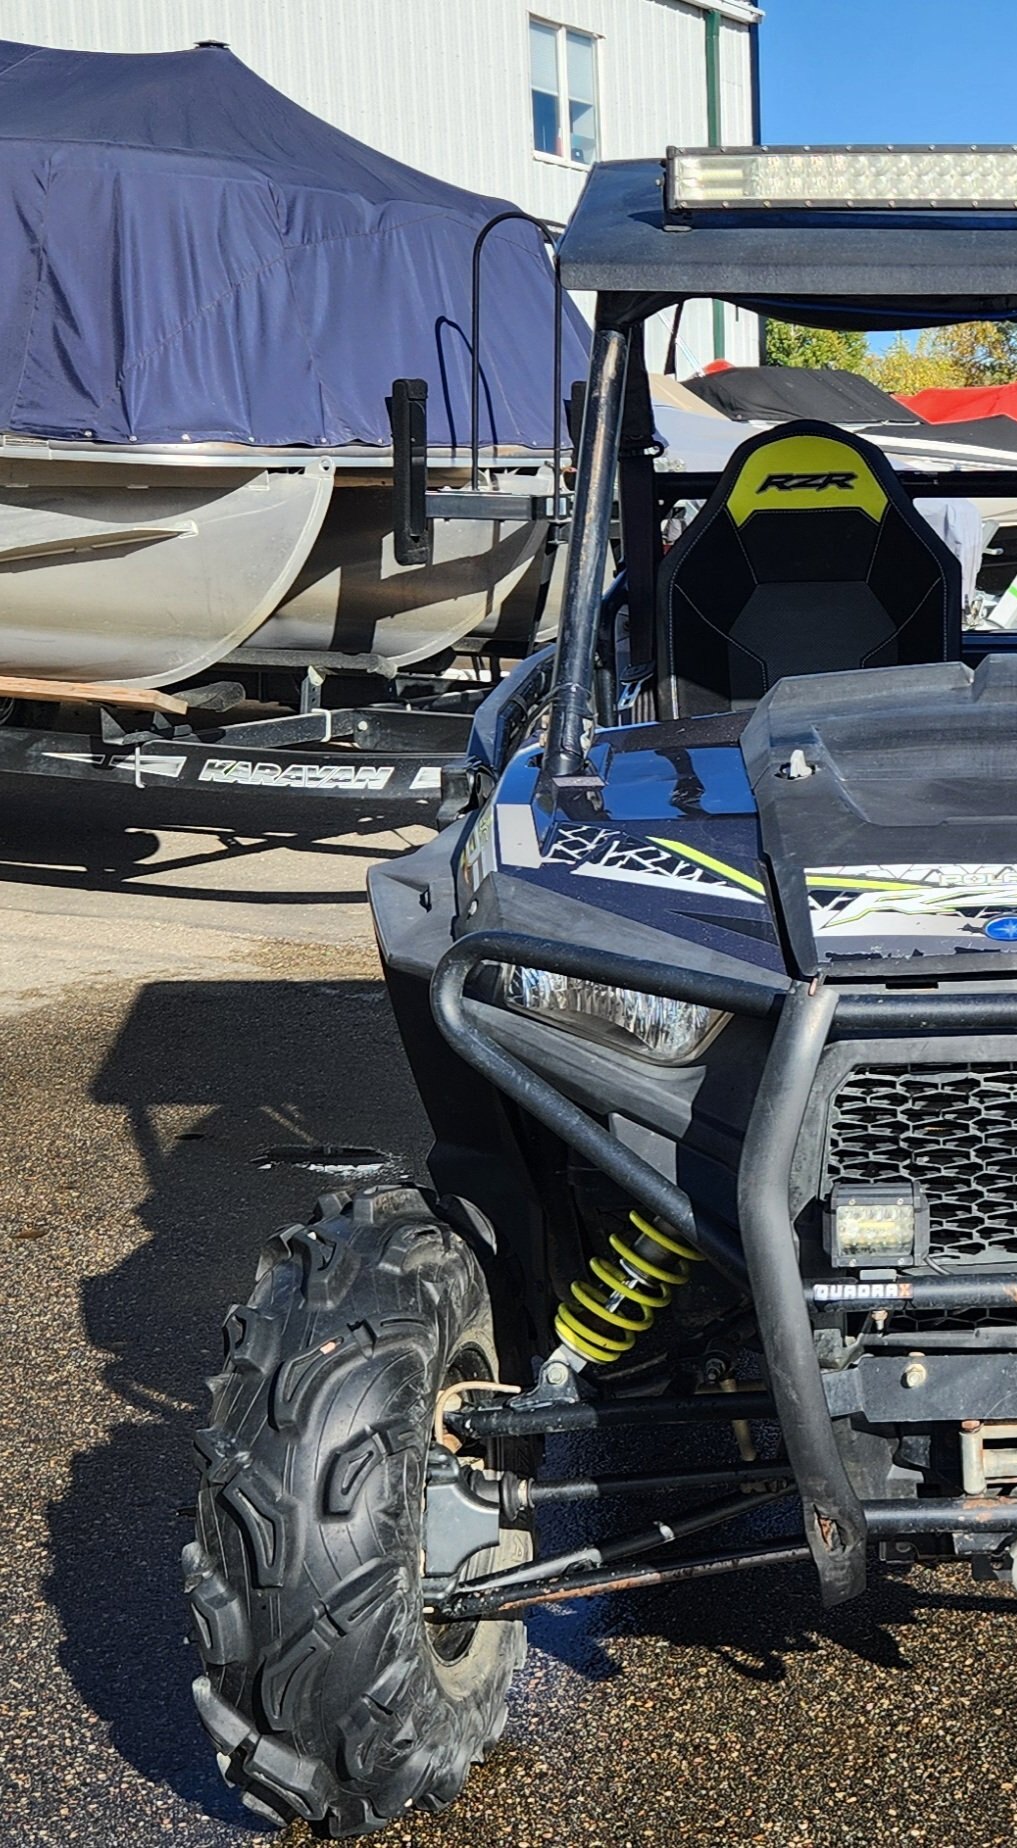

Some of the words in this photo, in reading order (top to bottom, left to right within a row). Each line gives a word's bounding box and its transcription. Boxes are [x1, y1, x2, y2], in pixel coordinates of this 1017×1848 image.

[756, 472, 857, 494] RZR
[198, 759, 394, 790] KARAVAN
[813, 1283, 913, 1300] QUADRAX
